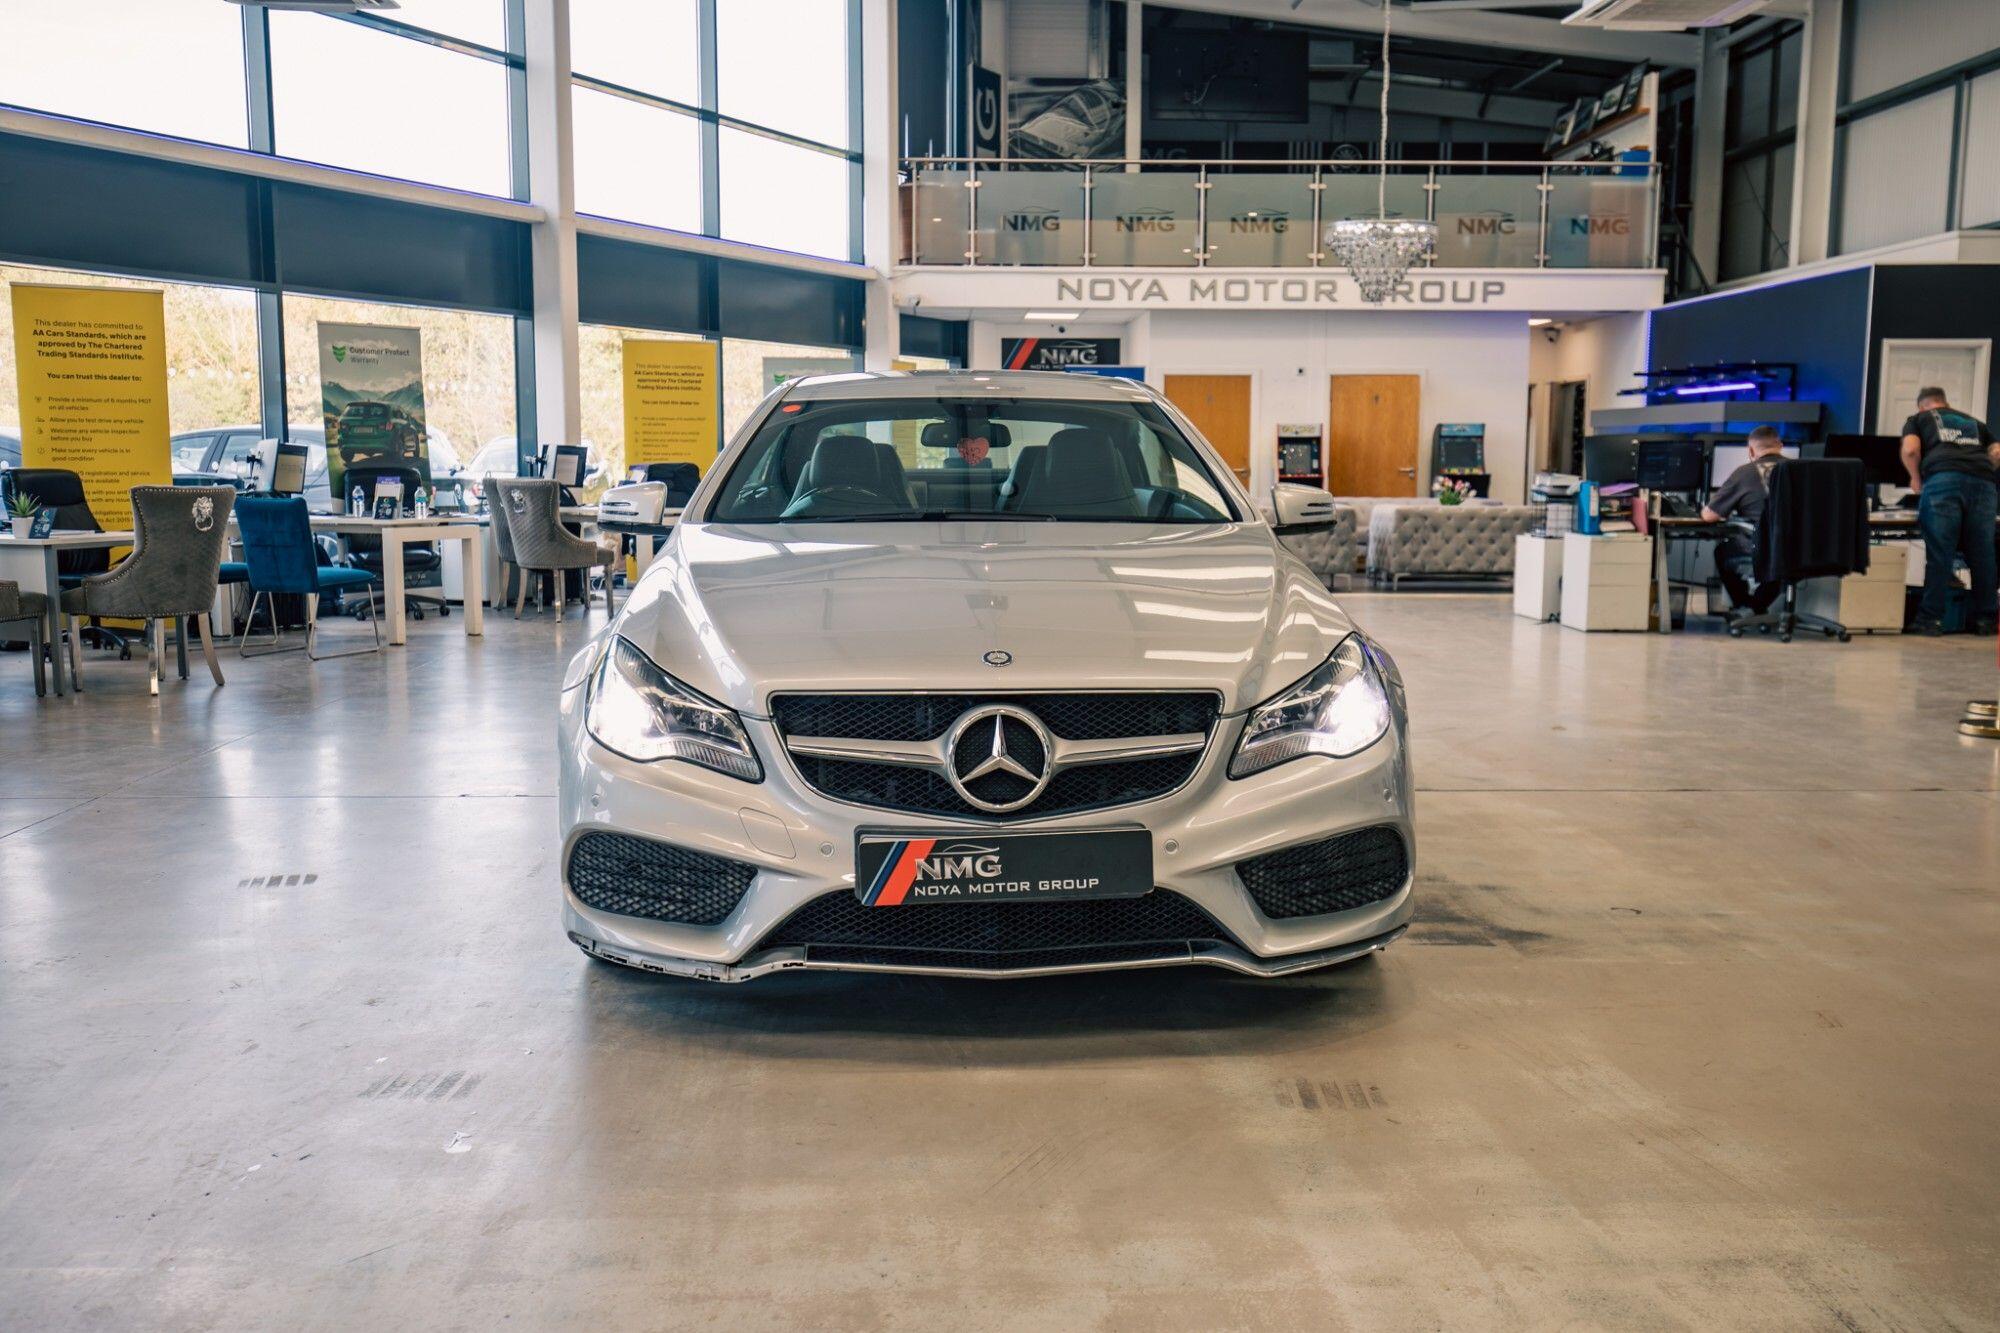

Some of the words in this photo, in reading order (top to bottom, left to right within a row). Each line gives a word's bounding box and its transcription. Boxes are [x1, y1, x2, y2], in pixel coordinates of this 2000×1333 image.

[1002, 215, 1060, 232] NMG
[1115, 215, 1176, 233] NMG
[1230, 216, 1289, 234] NMG
[1457, 218, 1515, 235] NMG
[1571, 218, 1630, 236] NMG
[1057, 278, 1168, 301] NOYA
[1189, 279, 1338, 302] MOTOR
[1362, 279, 1506, 303] ROUP
[66, 331, 108, 339] Standards,
[77, 341, 86, 349] by
[104, 342, 142, 350] Chartered
[37, 350, 67, 358] Trading
[69, 351, 108, 359] Standards
[1040, 348, 1098, 364] NMG
[915, 855, 1002, 880] NMG
[914, 885, 961, 896] NOYA
[969, 881, 1031, 894] MOTOR
[1039, 878, 1099, 890] GROUP
